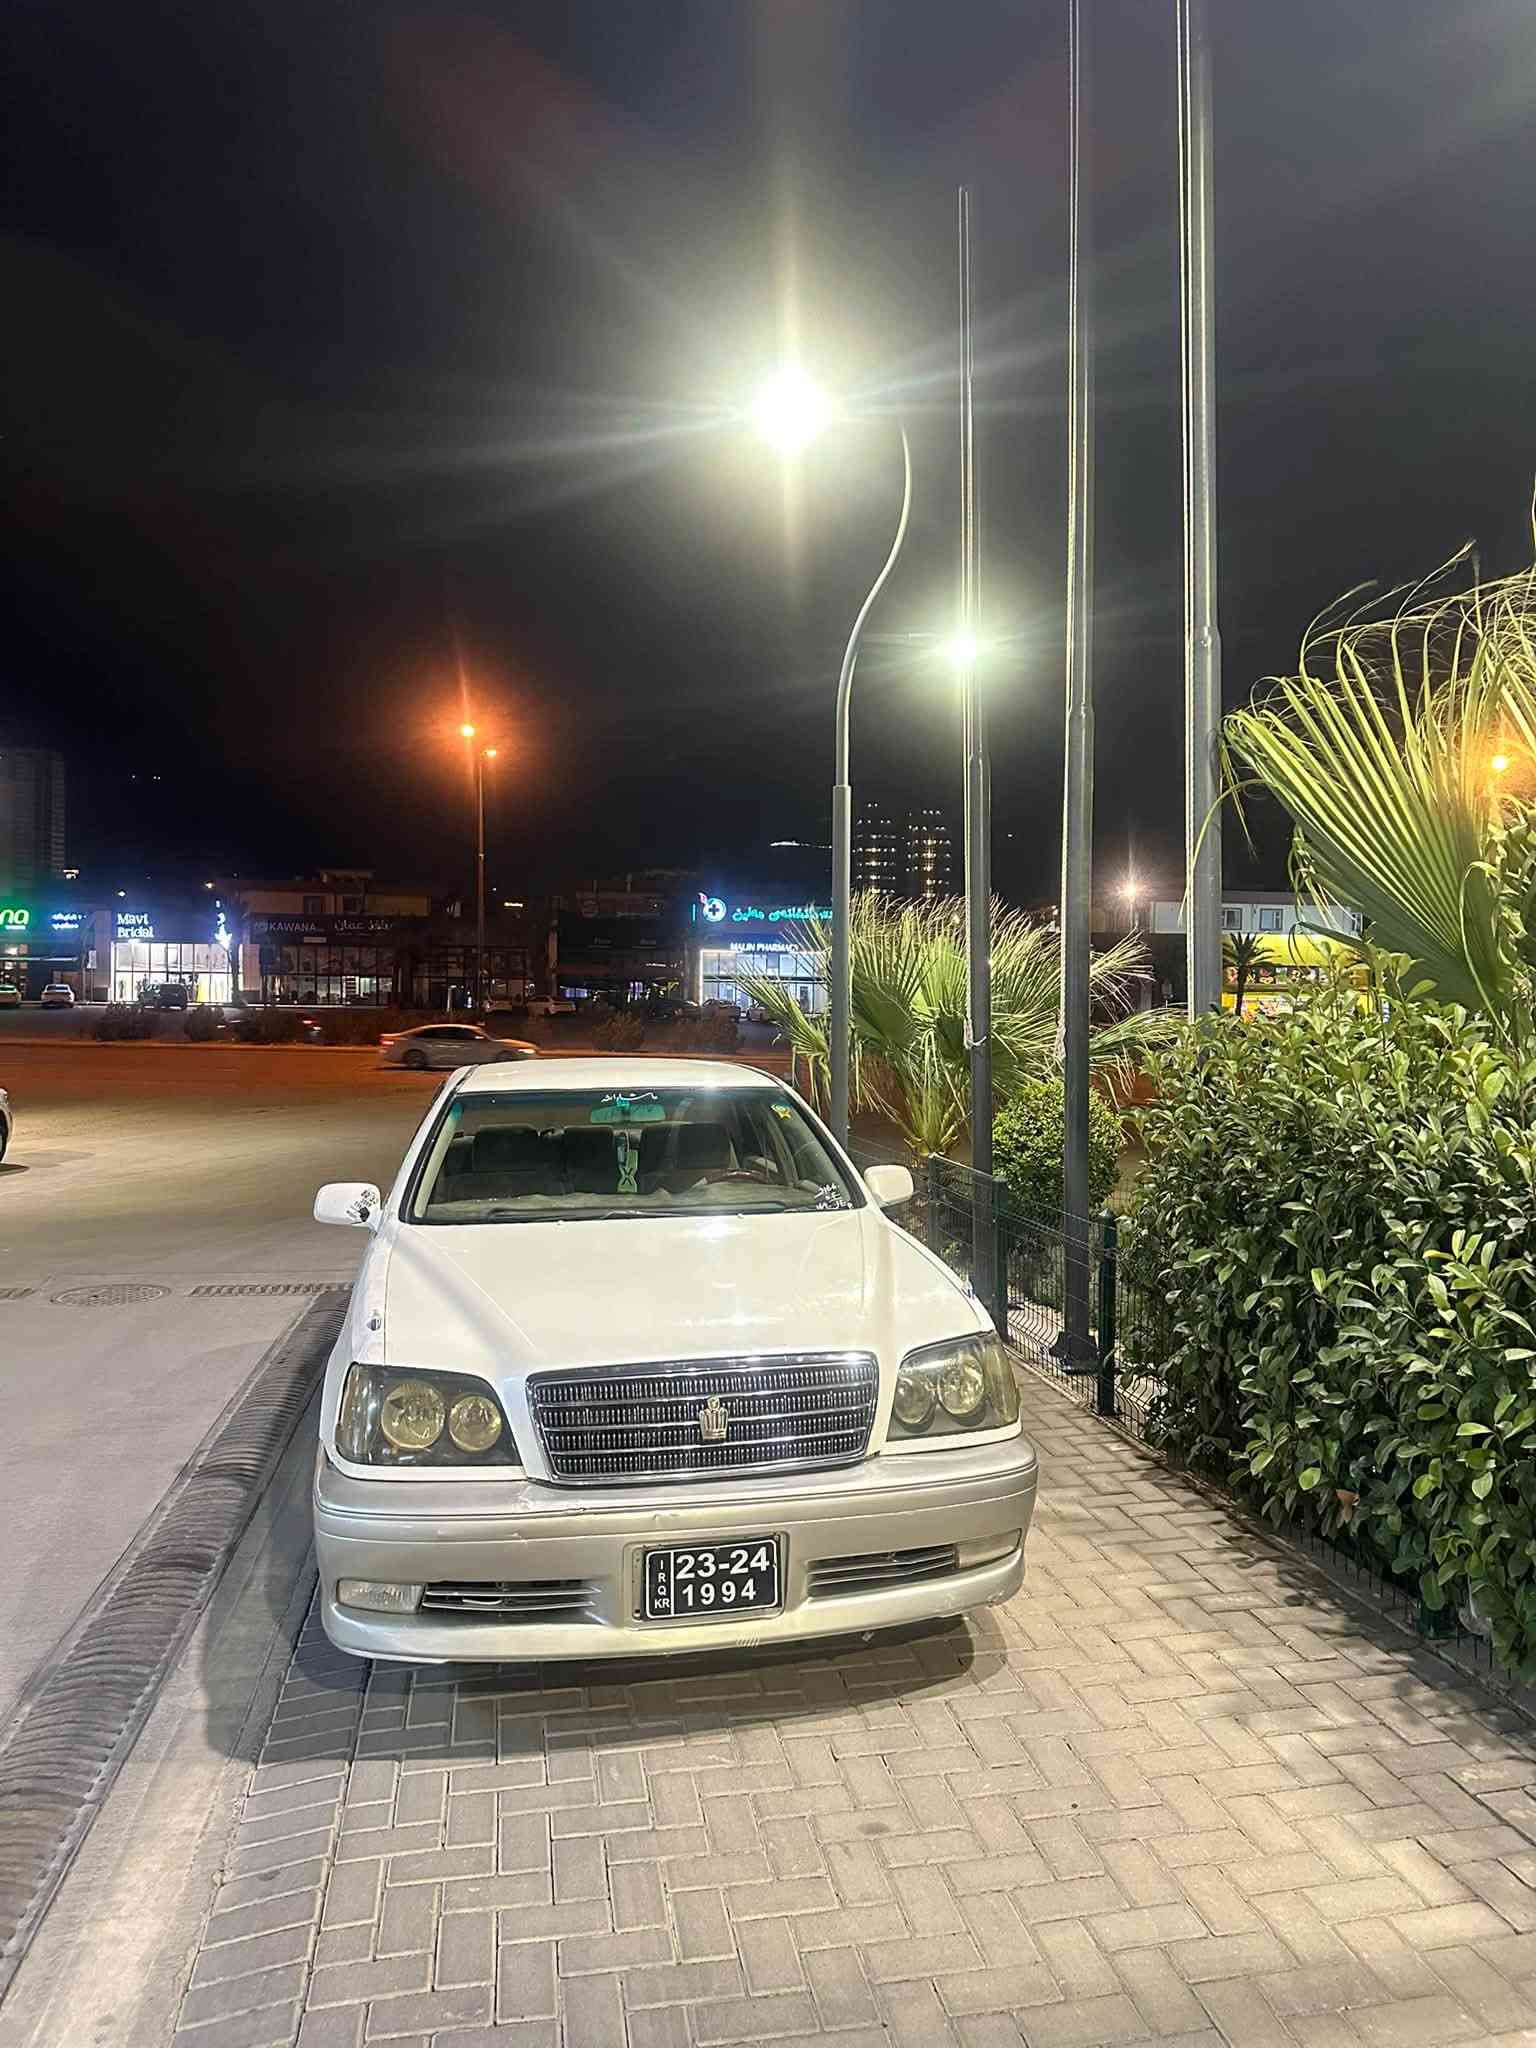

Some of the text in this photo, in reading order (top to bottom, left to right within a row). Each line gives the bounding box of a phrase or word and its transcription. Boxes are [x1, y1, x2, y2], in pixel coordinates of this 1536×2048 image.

[117, 926, 154, 938] Bridal
[730, 942, 799, 953] MALIN PHARMACY
[675, 1546, 770, 1580] 23-24
[681, 1578, 757, 1607] 1994
[654, 1598, 671, 1609] KR
